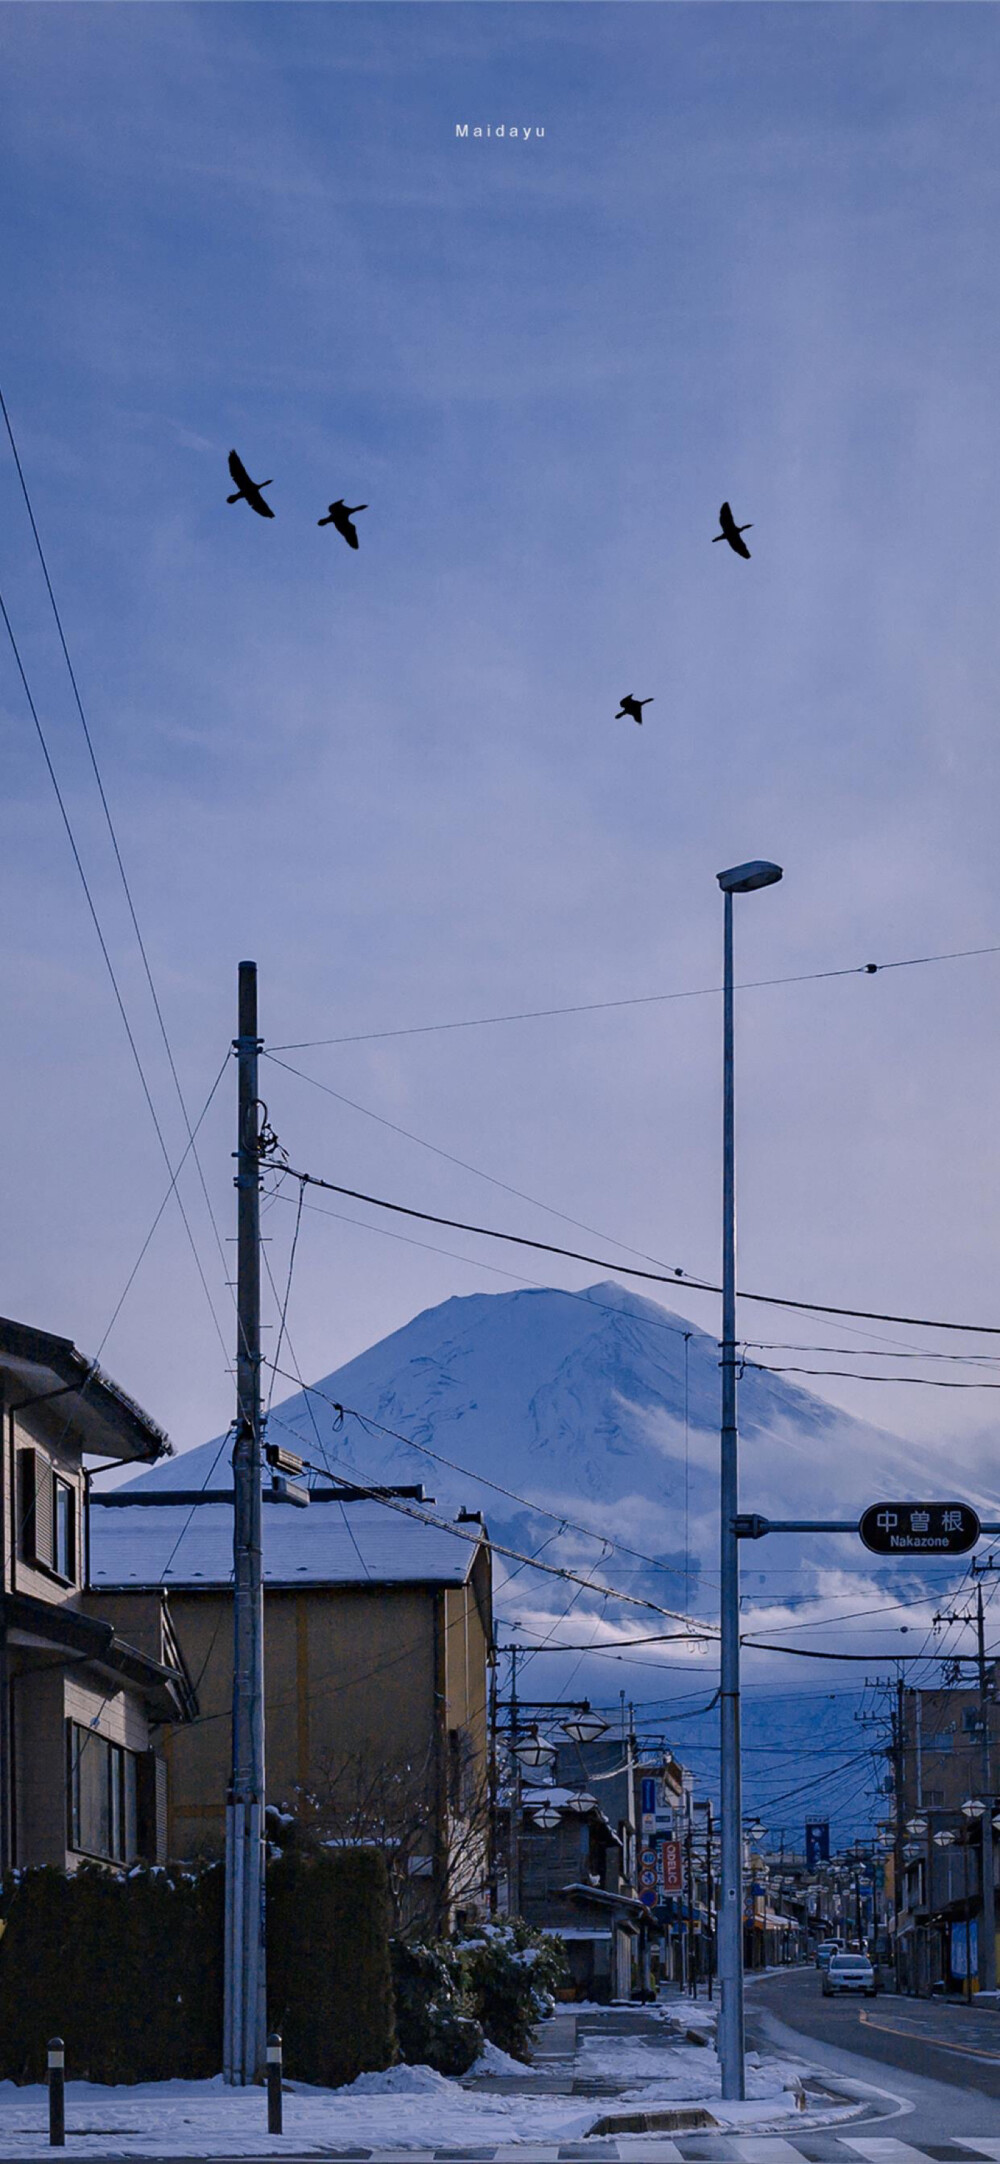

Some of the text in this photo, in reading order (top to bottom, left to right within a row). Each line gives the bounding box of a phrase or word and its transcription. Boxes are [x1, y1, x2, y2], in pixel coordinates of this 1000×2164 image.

[877, 1510, 964, 1532] 中曽根
[890, 1535, 950, 1547] Nakazone
[667, 1845, 677, 1884] ODELIC
